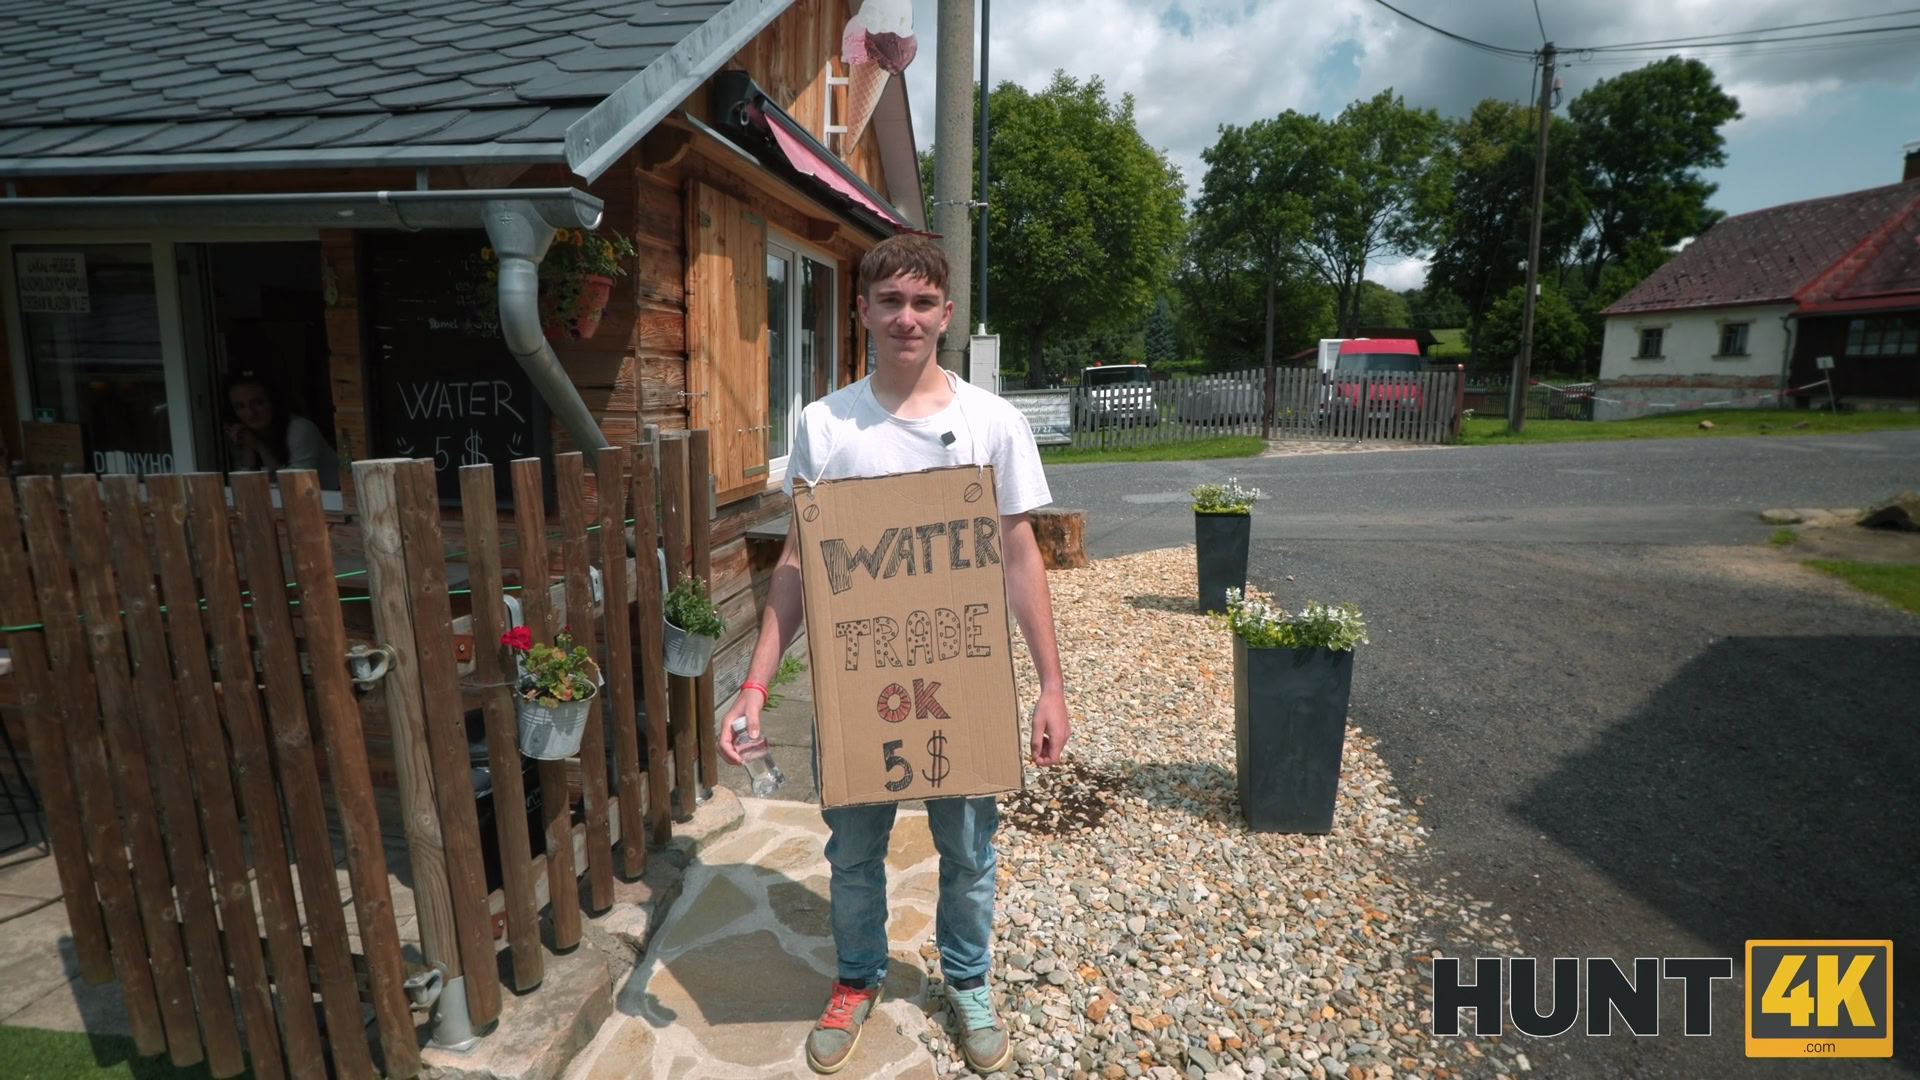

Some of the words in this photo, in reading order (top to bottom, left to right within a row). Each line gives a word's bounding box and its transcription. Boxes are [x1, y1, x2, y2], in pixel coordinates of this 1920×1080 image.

[396, 380, 526, 424] WATER
[820, 516, 1000, 595] WATER
[835, 603, 992, 671] TRADE
[876, 678, 951, 723] OK
